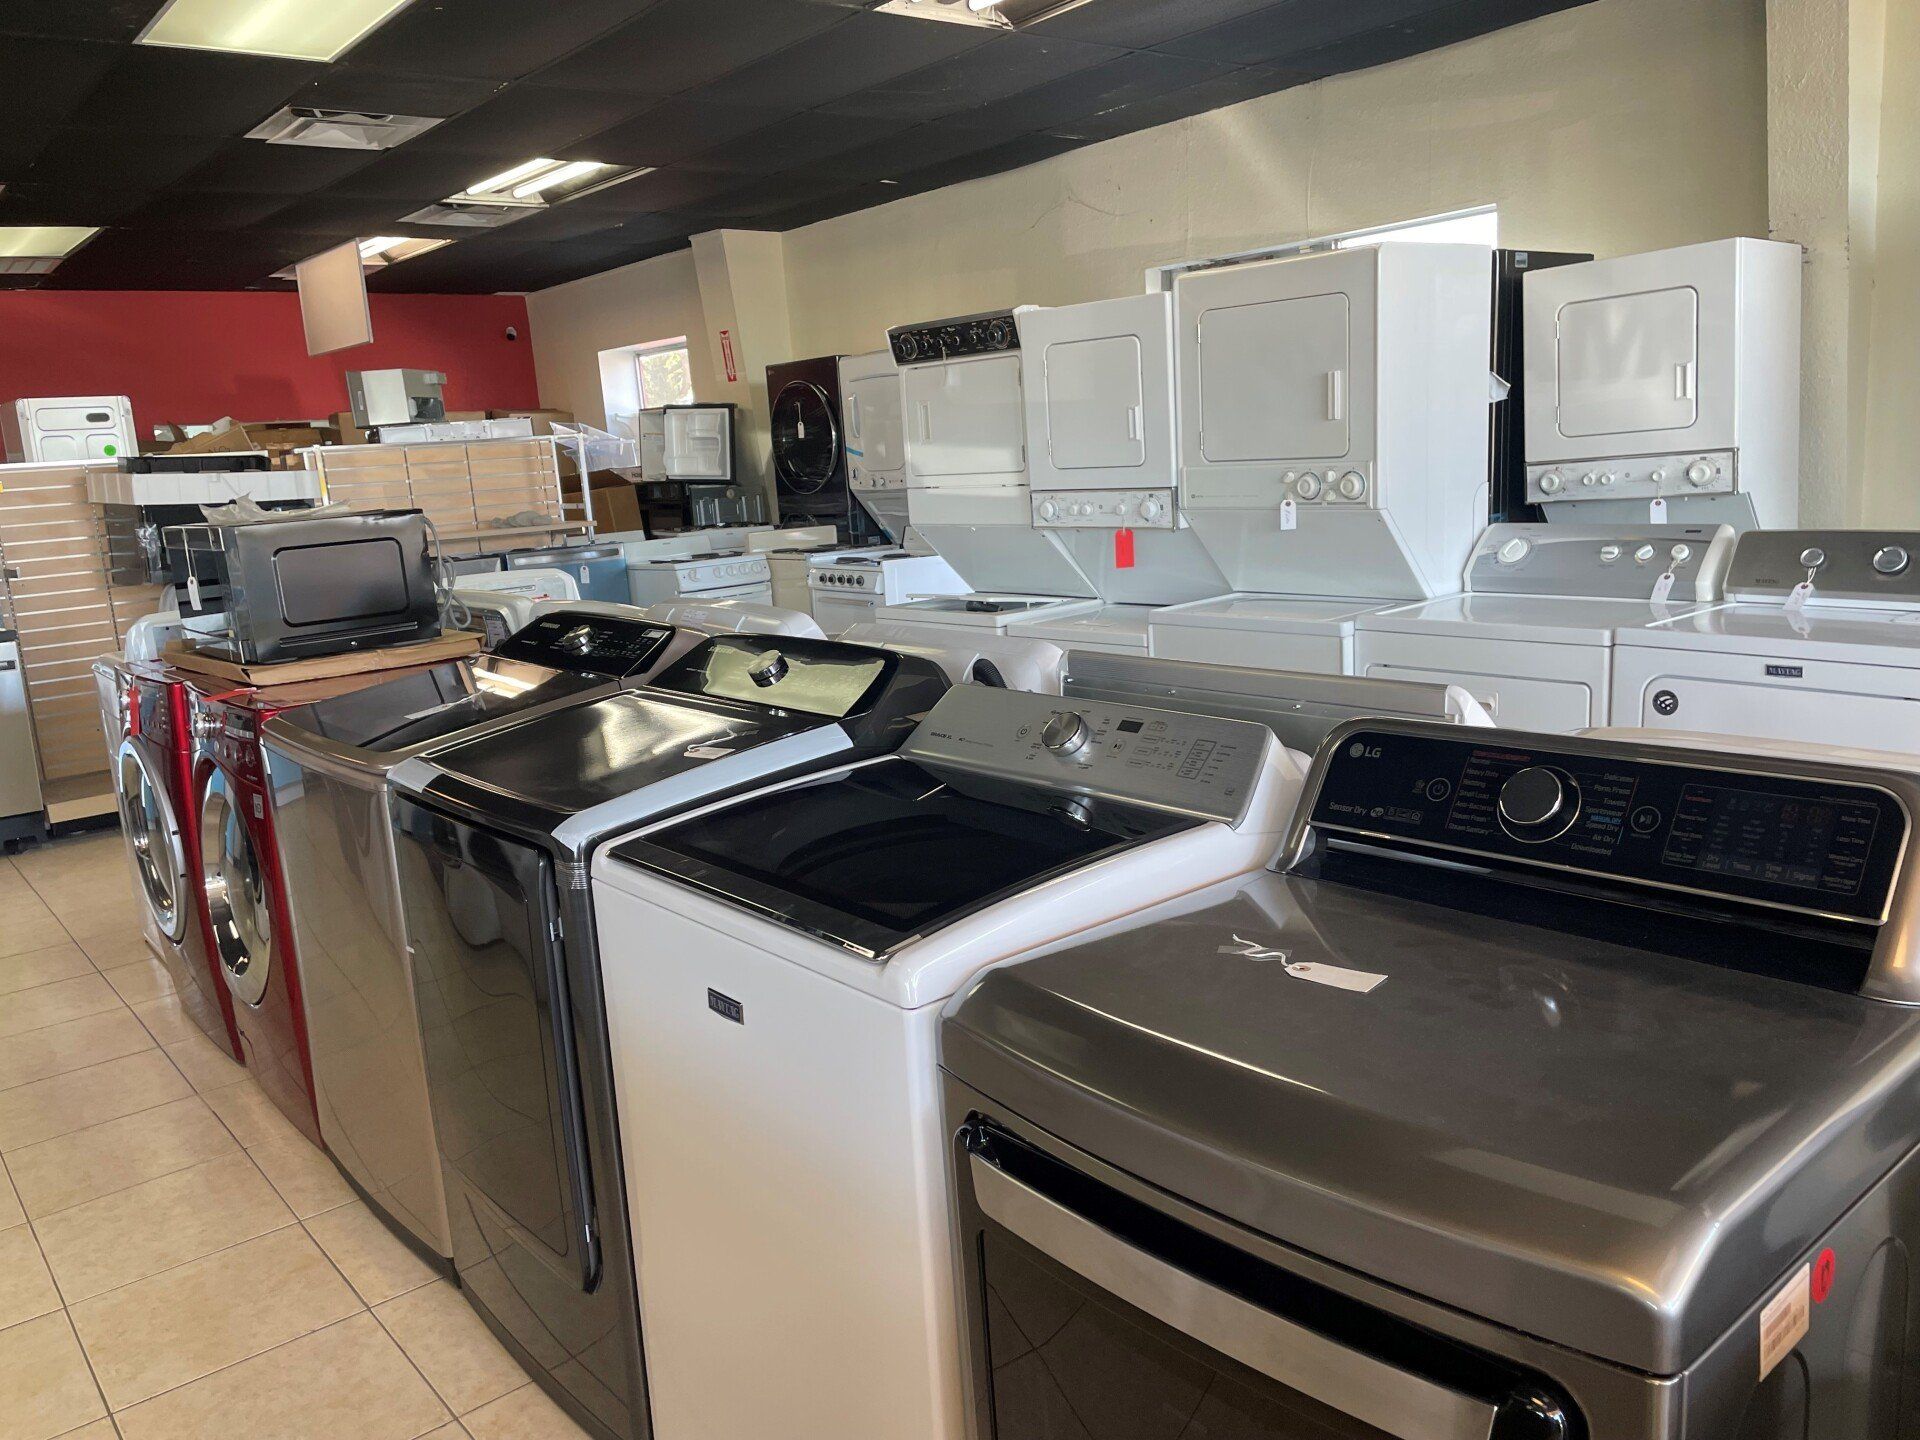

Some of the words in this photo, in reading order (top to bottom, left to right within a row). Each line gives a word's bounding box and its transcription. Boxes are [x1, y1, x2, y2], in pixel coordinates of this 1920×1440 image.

[1768, 667, 1801, 676] MAYTAG
[1365, 747, 1381, 758] LG
[1328, 801, 1353, 813] Sensor
[1354, 805, 1367, 816] Dry
[1585, 821, 1607, 829] Speed
[1607, 823, 1620, 832] Dry
[1603, 835, 1616, 844] Dry
